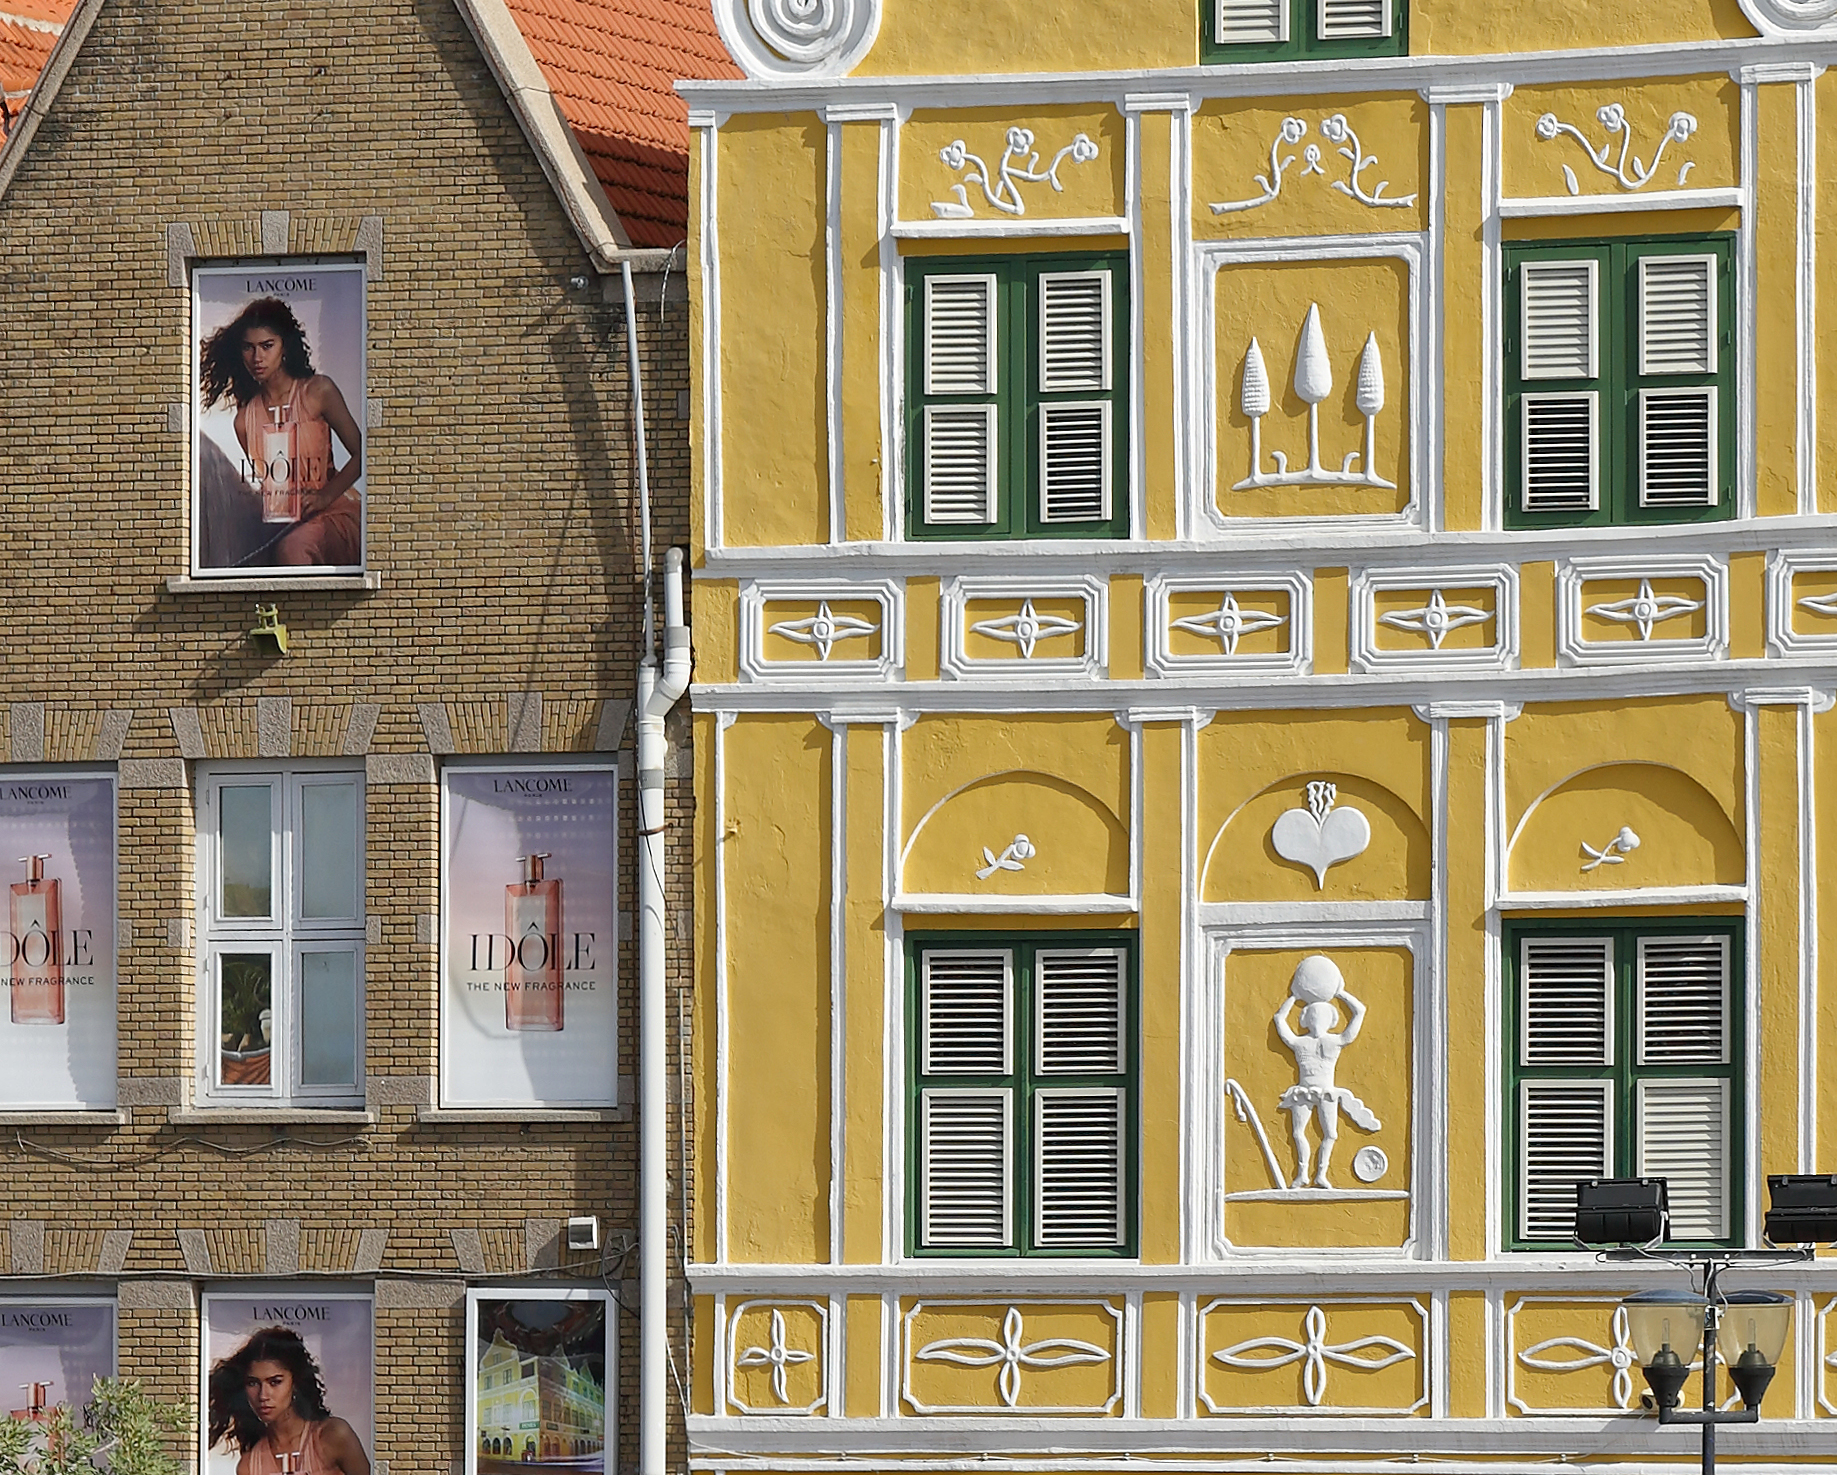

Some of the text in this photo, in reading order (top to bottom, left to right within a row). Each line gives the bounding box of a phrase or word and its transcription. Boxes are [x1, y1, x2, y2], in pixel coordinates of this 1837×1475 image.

[468, 921, 596, 972] IDÔLE
[28, 976, 94, 986] FRAGRANCE
[467, 981, 596, 991] THE NEW FRAGRANCE
